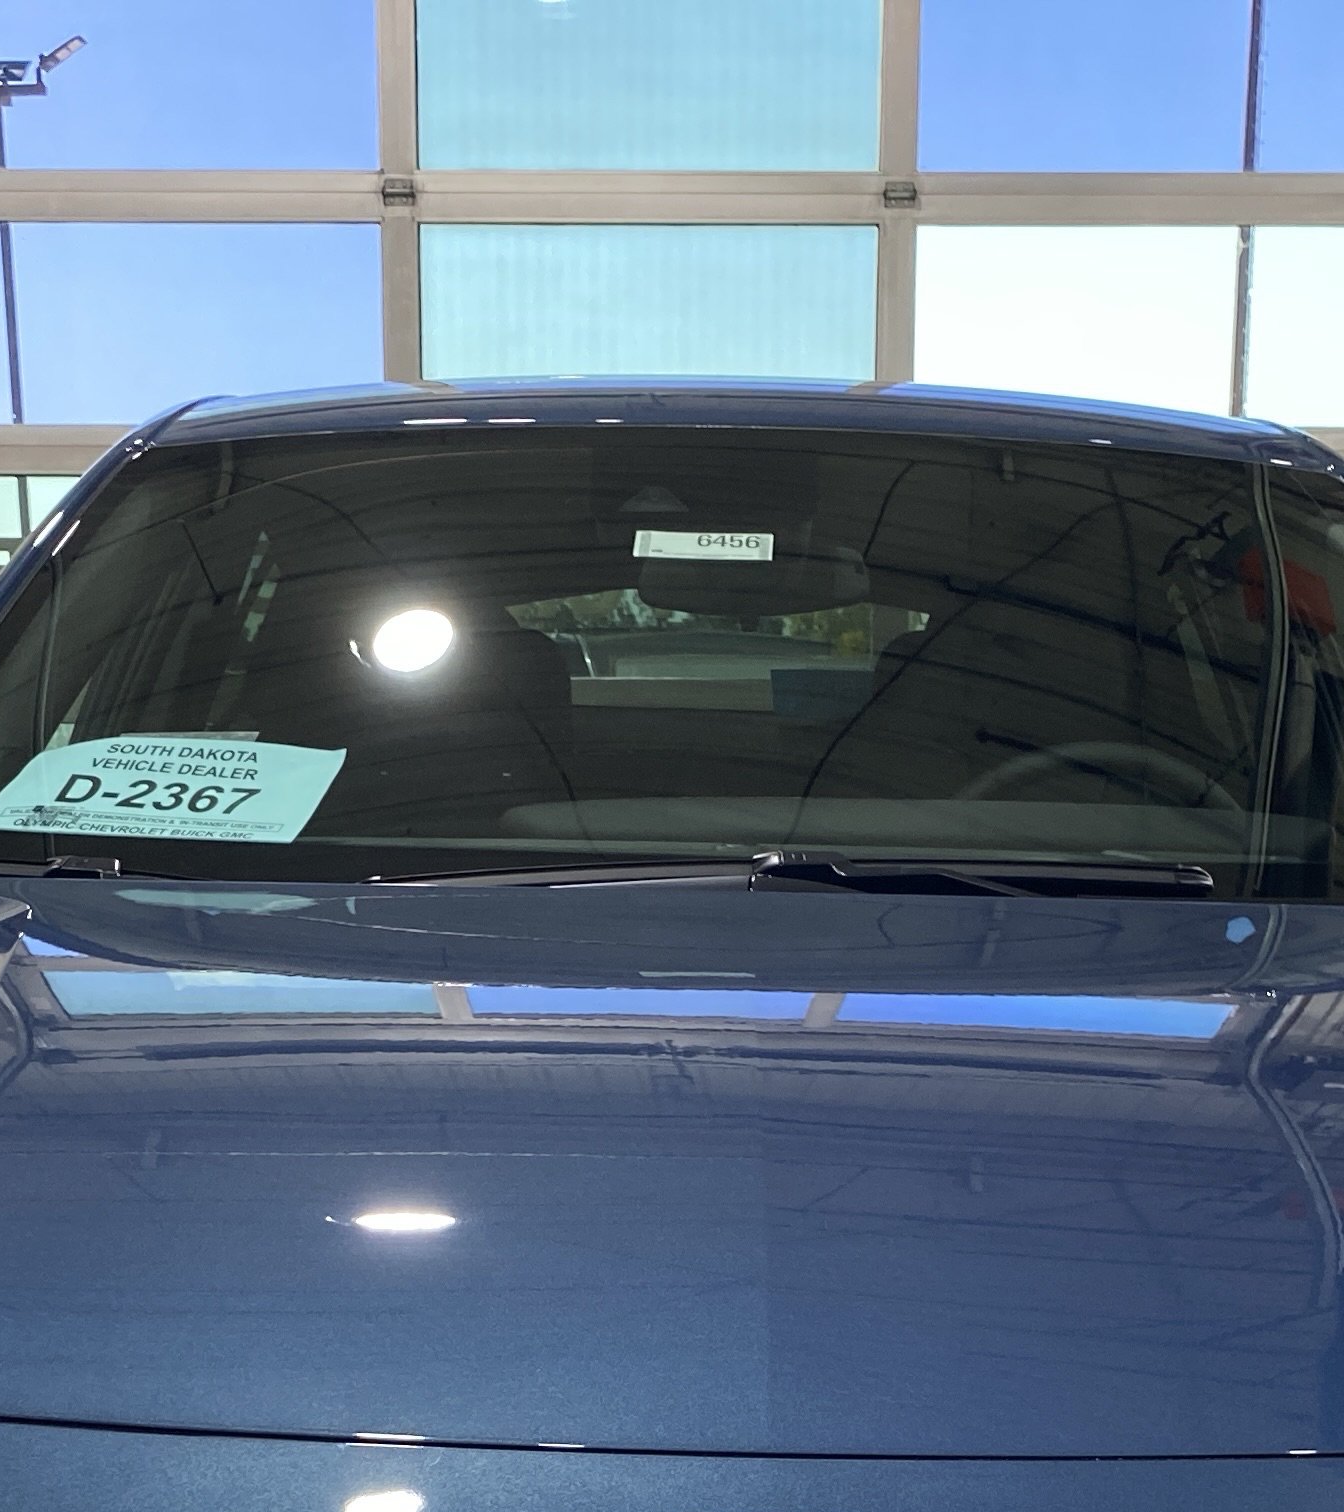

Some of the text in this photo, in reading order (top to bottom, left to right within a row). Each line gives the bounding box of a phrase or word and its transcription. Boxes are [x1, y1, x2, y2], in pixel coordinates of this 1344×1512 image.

[697, 534, 761, 549] 6456
[107, 743, 258, 763] SOUTH DAKOTA
[92, 757, 258, 780] VEHICLE DEALER
[54, 774, 262, 815] D-2367
[13, 818, 255, 839] OLYMPIC CHEVROLET BUICK GMC
[91, 814, 167, 824] DEMONSTRATION
